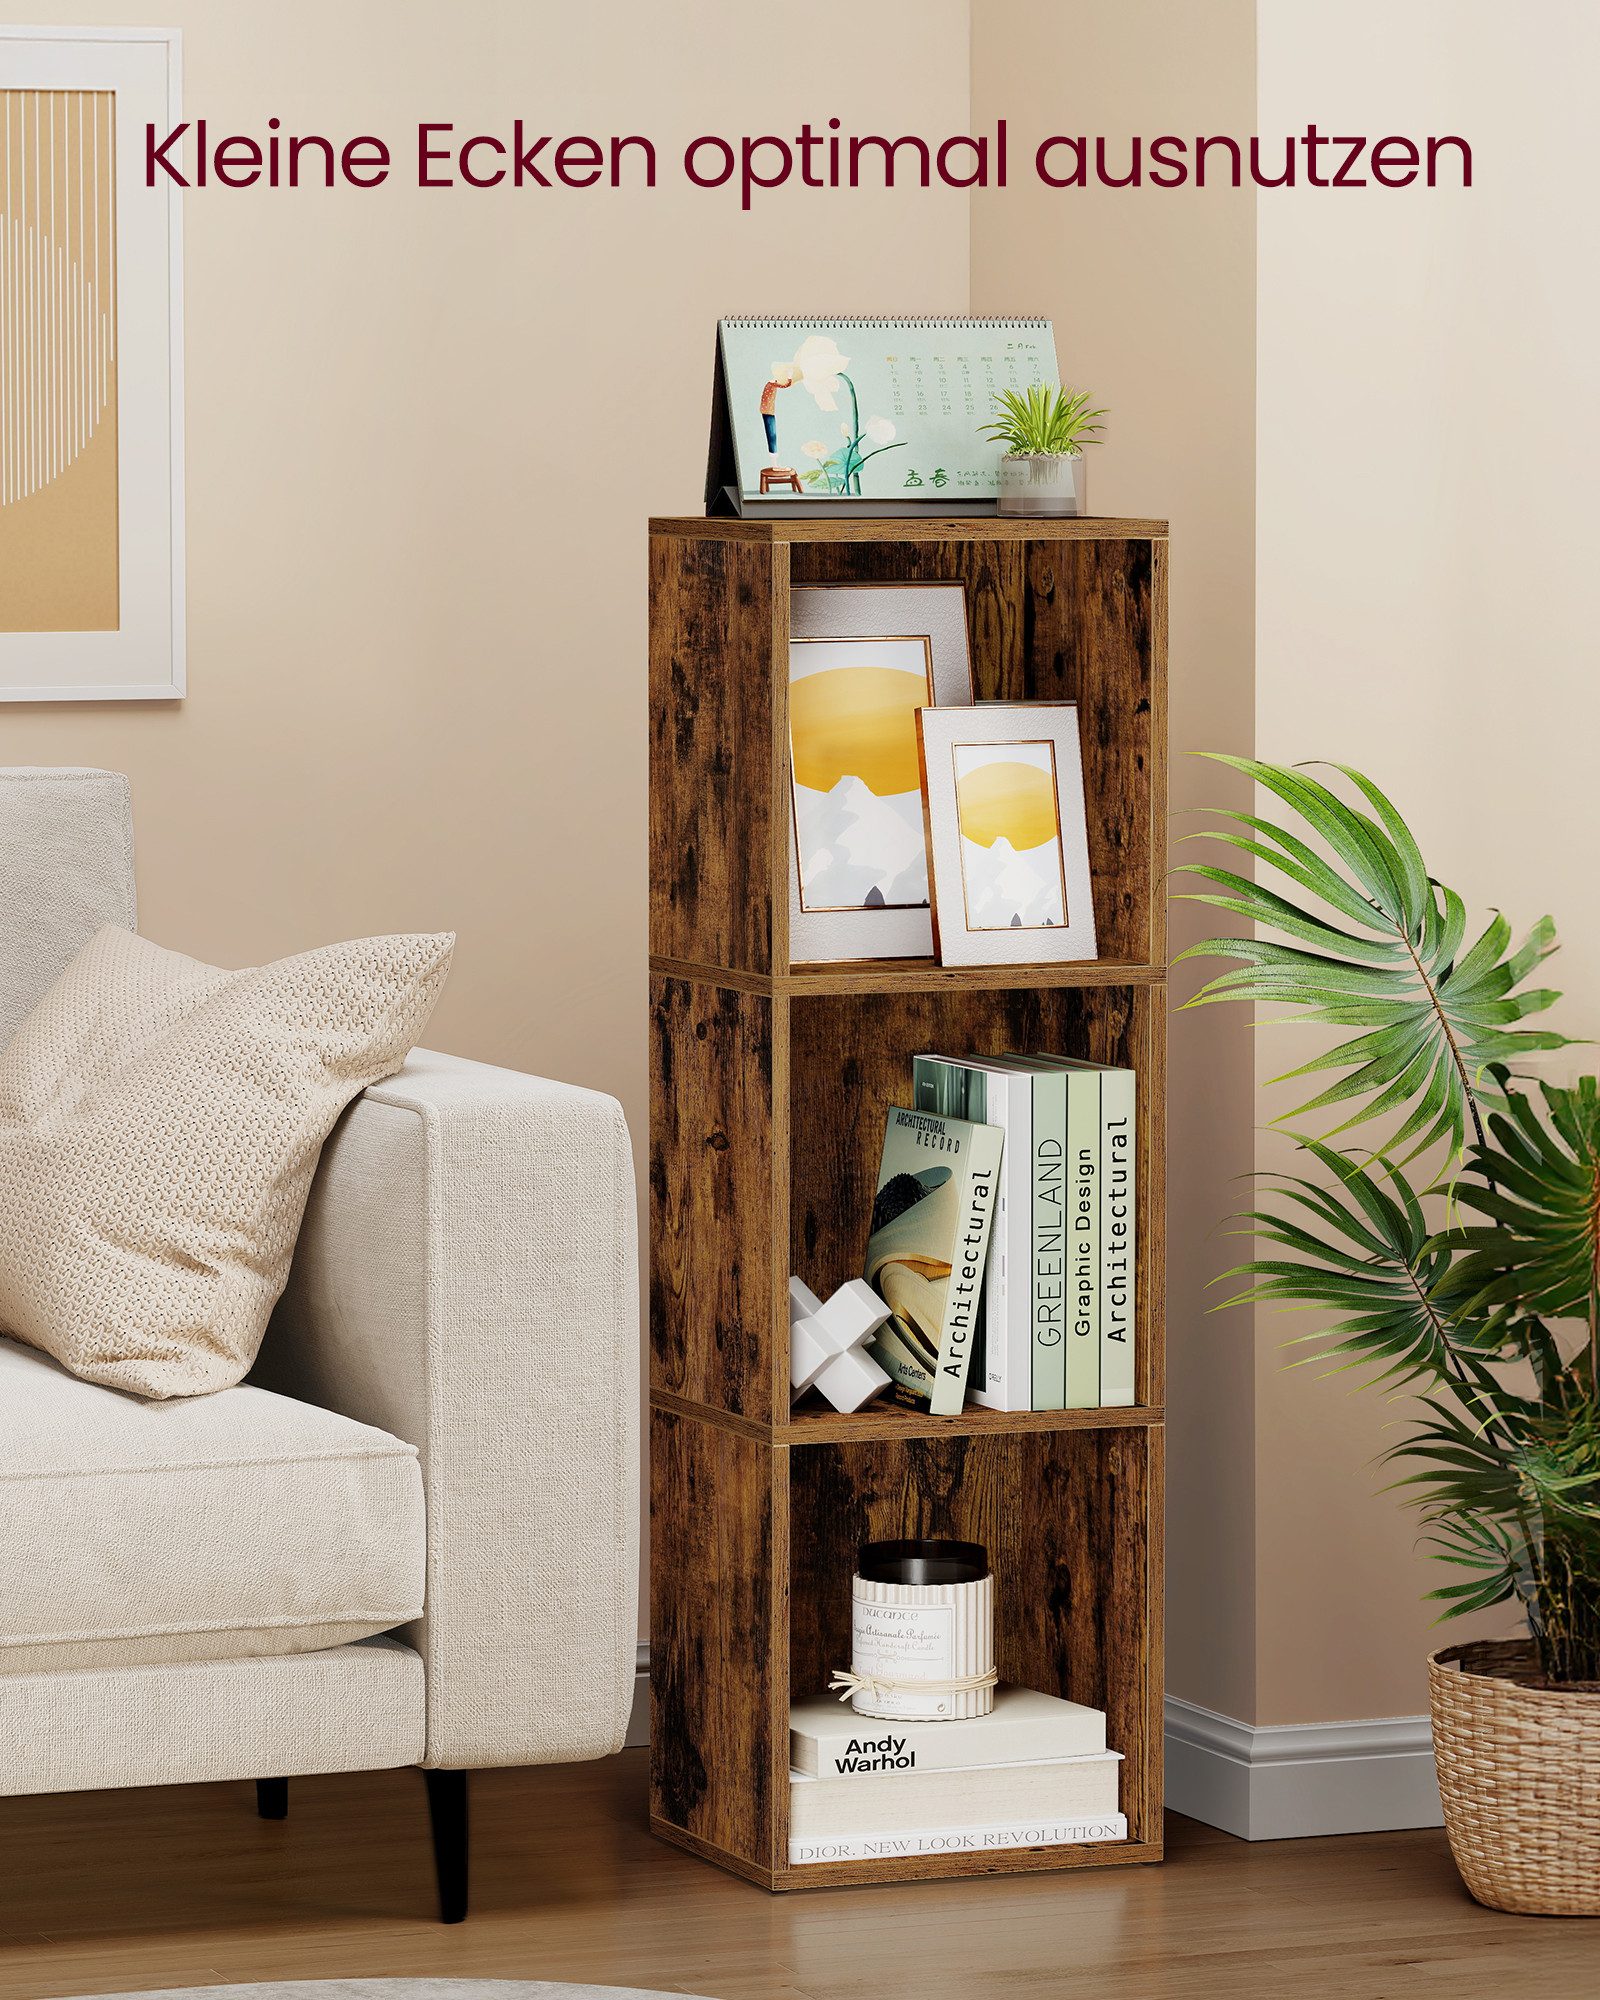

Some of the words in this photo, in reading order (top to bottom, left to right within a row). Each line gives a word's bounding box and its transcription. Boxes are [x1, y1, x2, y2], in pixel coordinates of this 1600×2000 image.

[895, 1111, 946, 1136] ARCHITECTURAL
[916, 1131, 960, 1154] RECORD
[1074, 1148, 1096, 1231] Design
[1037, 1138, 1063, 1347] GREENLAND
[1107, 1117, 1128, 1344] Architectural
[943, 1169, 992, 1379] Architectural
[1074, 1242, 1096, 1337] Graphic
[835, 1751, 916, 1774] Warhol
[845, 1735, 906, 1756] Andy
[799, 1843, 856, 1860] DIOR.
[863, 1839, 911, 1857] NEW
[918, 1834, 975, 1851] LOOK
[983, 1824, 1118, 1846] REVOLUTION
